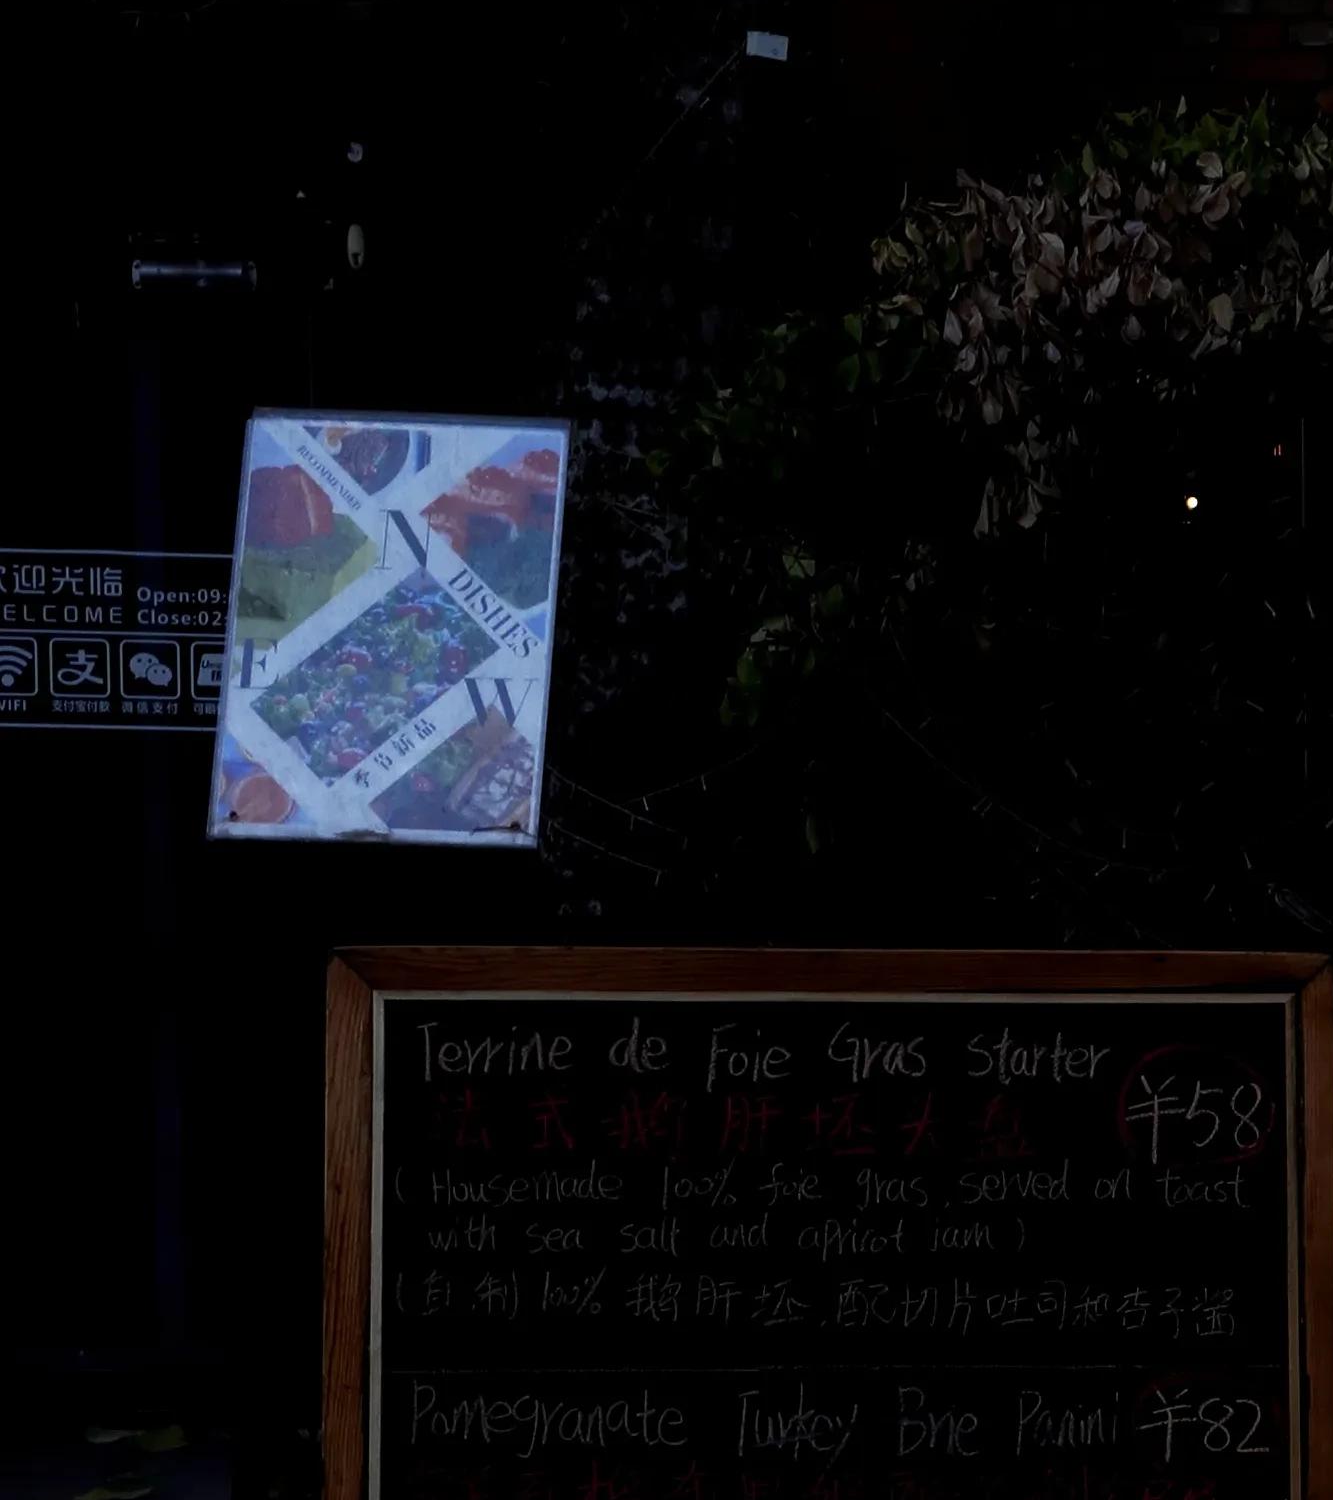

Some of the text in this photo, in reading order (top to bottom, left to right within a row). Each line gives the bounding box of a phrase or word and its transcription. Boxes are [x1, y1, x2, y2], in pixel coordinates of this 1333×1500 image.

[296, 444, 361, 511] RECOMMENDED
[447, 568, 539, 659] DISHES
[416, 1019, 576, 1083] Terrine
[607, 1016, 672, 1076] de
[706, 1021, 793, 1093] Foie
[828, 1021, 927, 1084] Gras
[1157, 1165, 1251, 1208] toast
[427, 1213, 497, 1253] with
[525, 1226, 584, 1254] sea
[709, 1212, 769, 1250] and
[410, 1380, 688, 1458] Pomegranate
